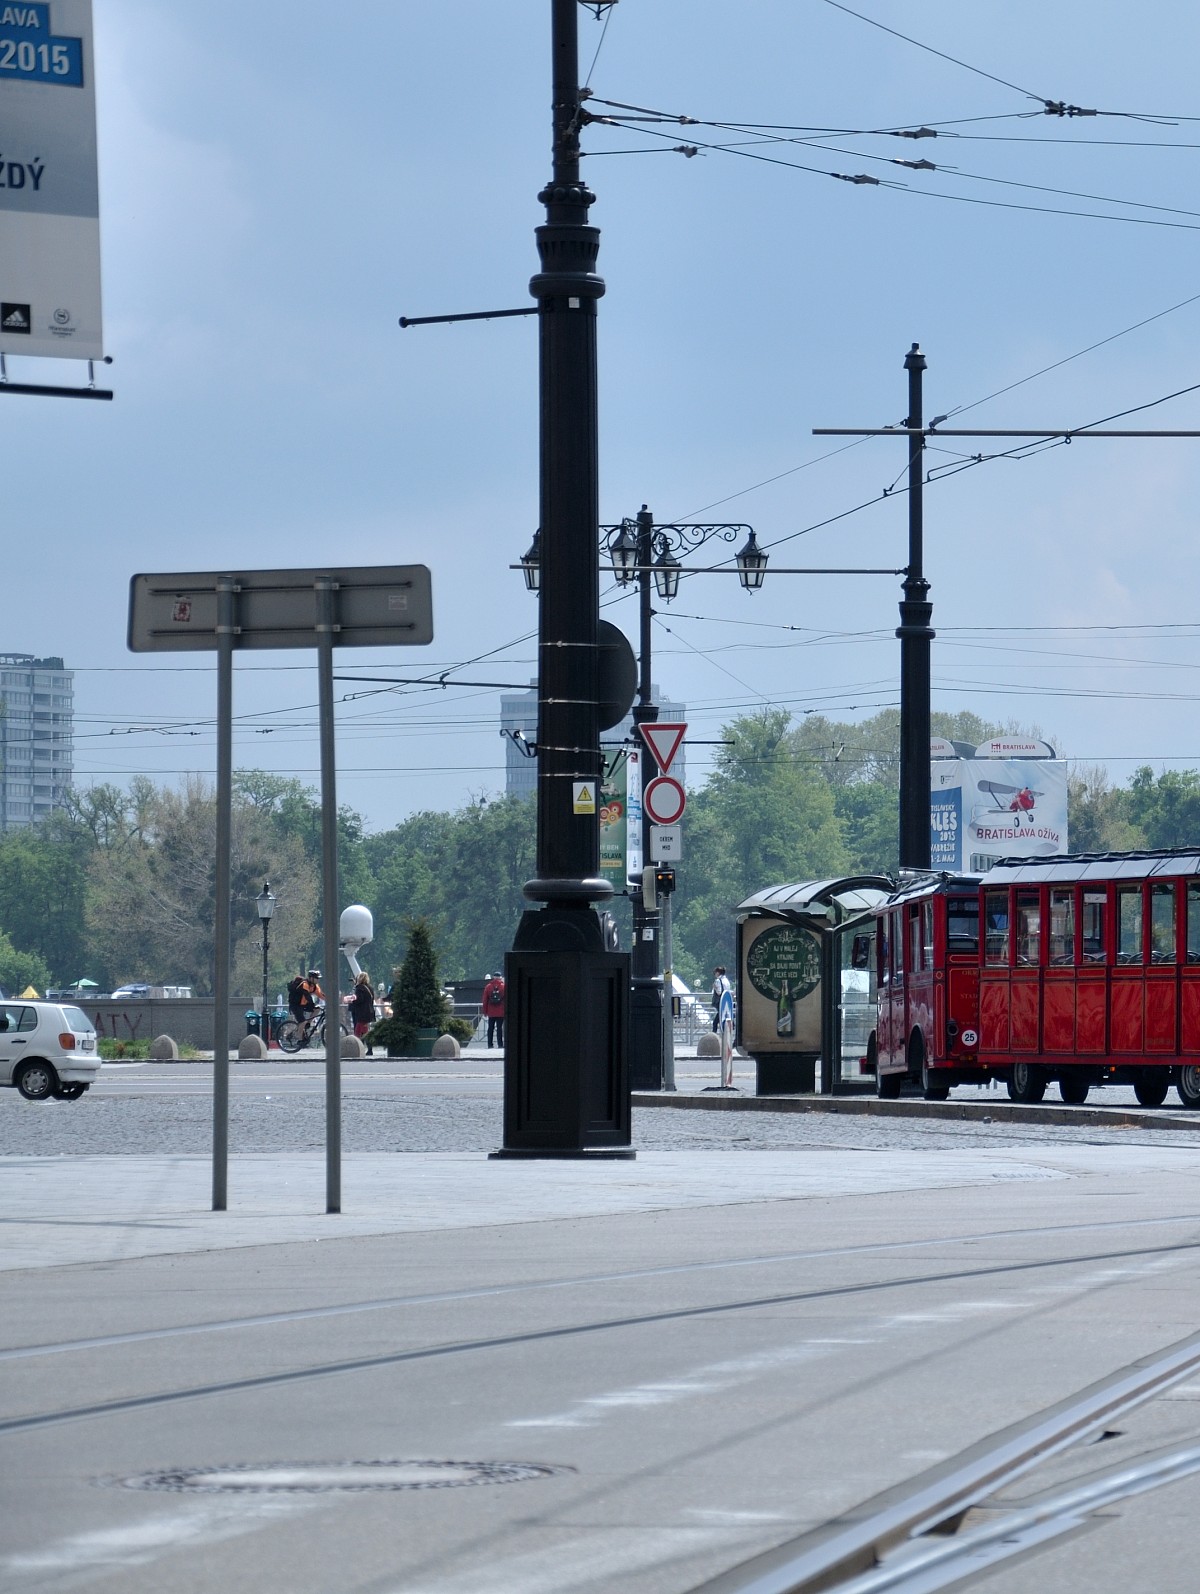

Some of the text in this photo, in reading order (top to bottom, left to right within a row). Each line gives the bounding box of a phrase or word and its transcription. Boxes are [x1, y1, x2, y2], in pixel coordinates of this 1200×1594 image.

[0, 7, 40, 28] AVA
[0, 40, 70, 75] 2015
[976, 828, 1059, 842] BRATISLAVA OŽÍVA
[964, 1033, 975, 1042] 25
